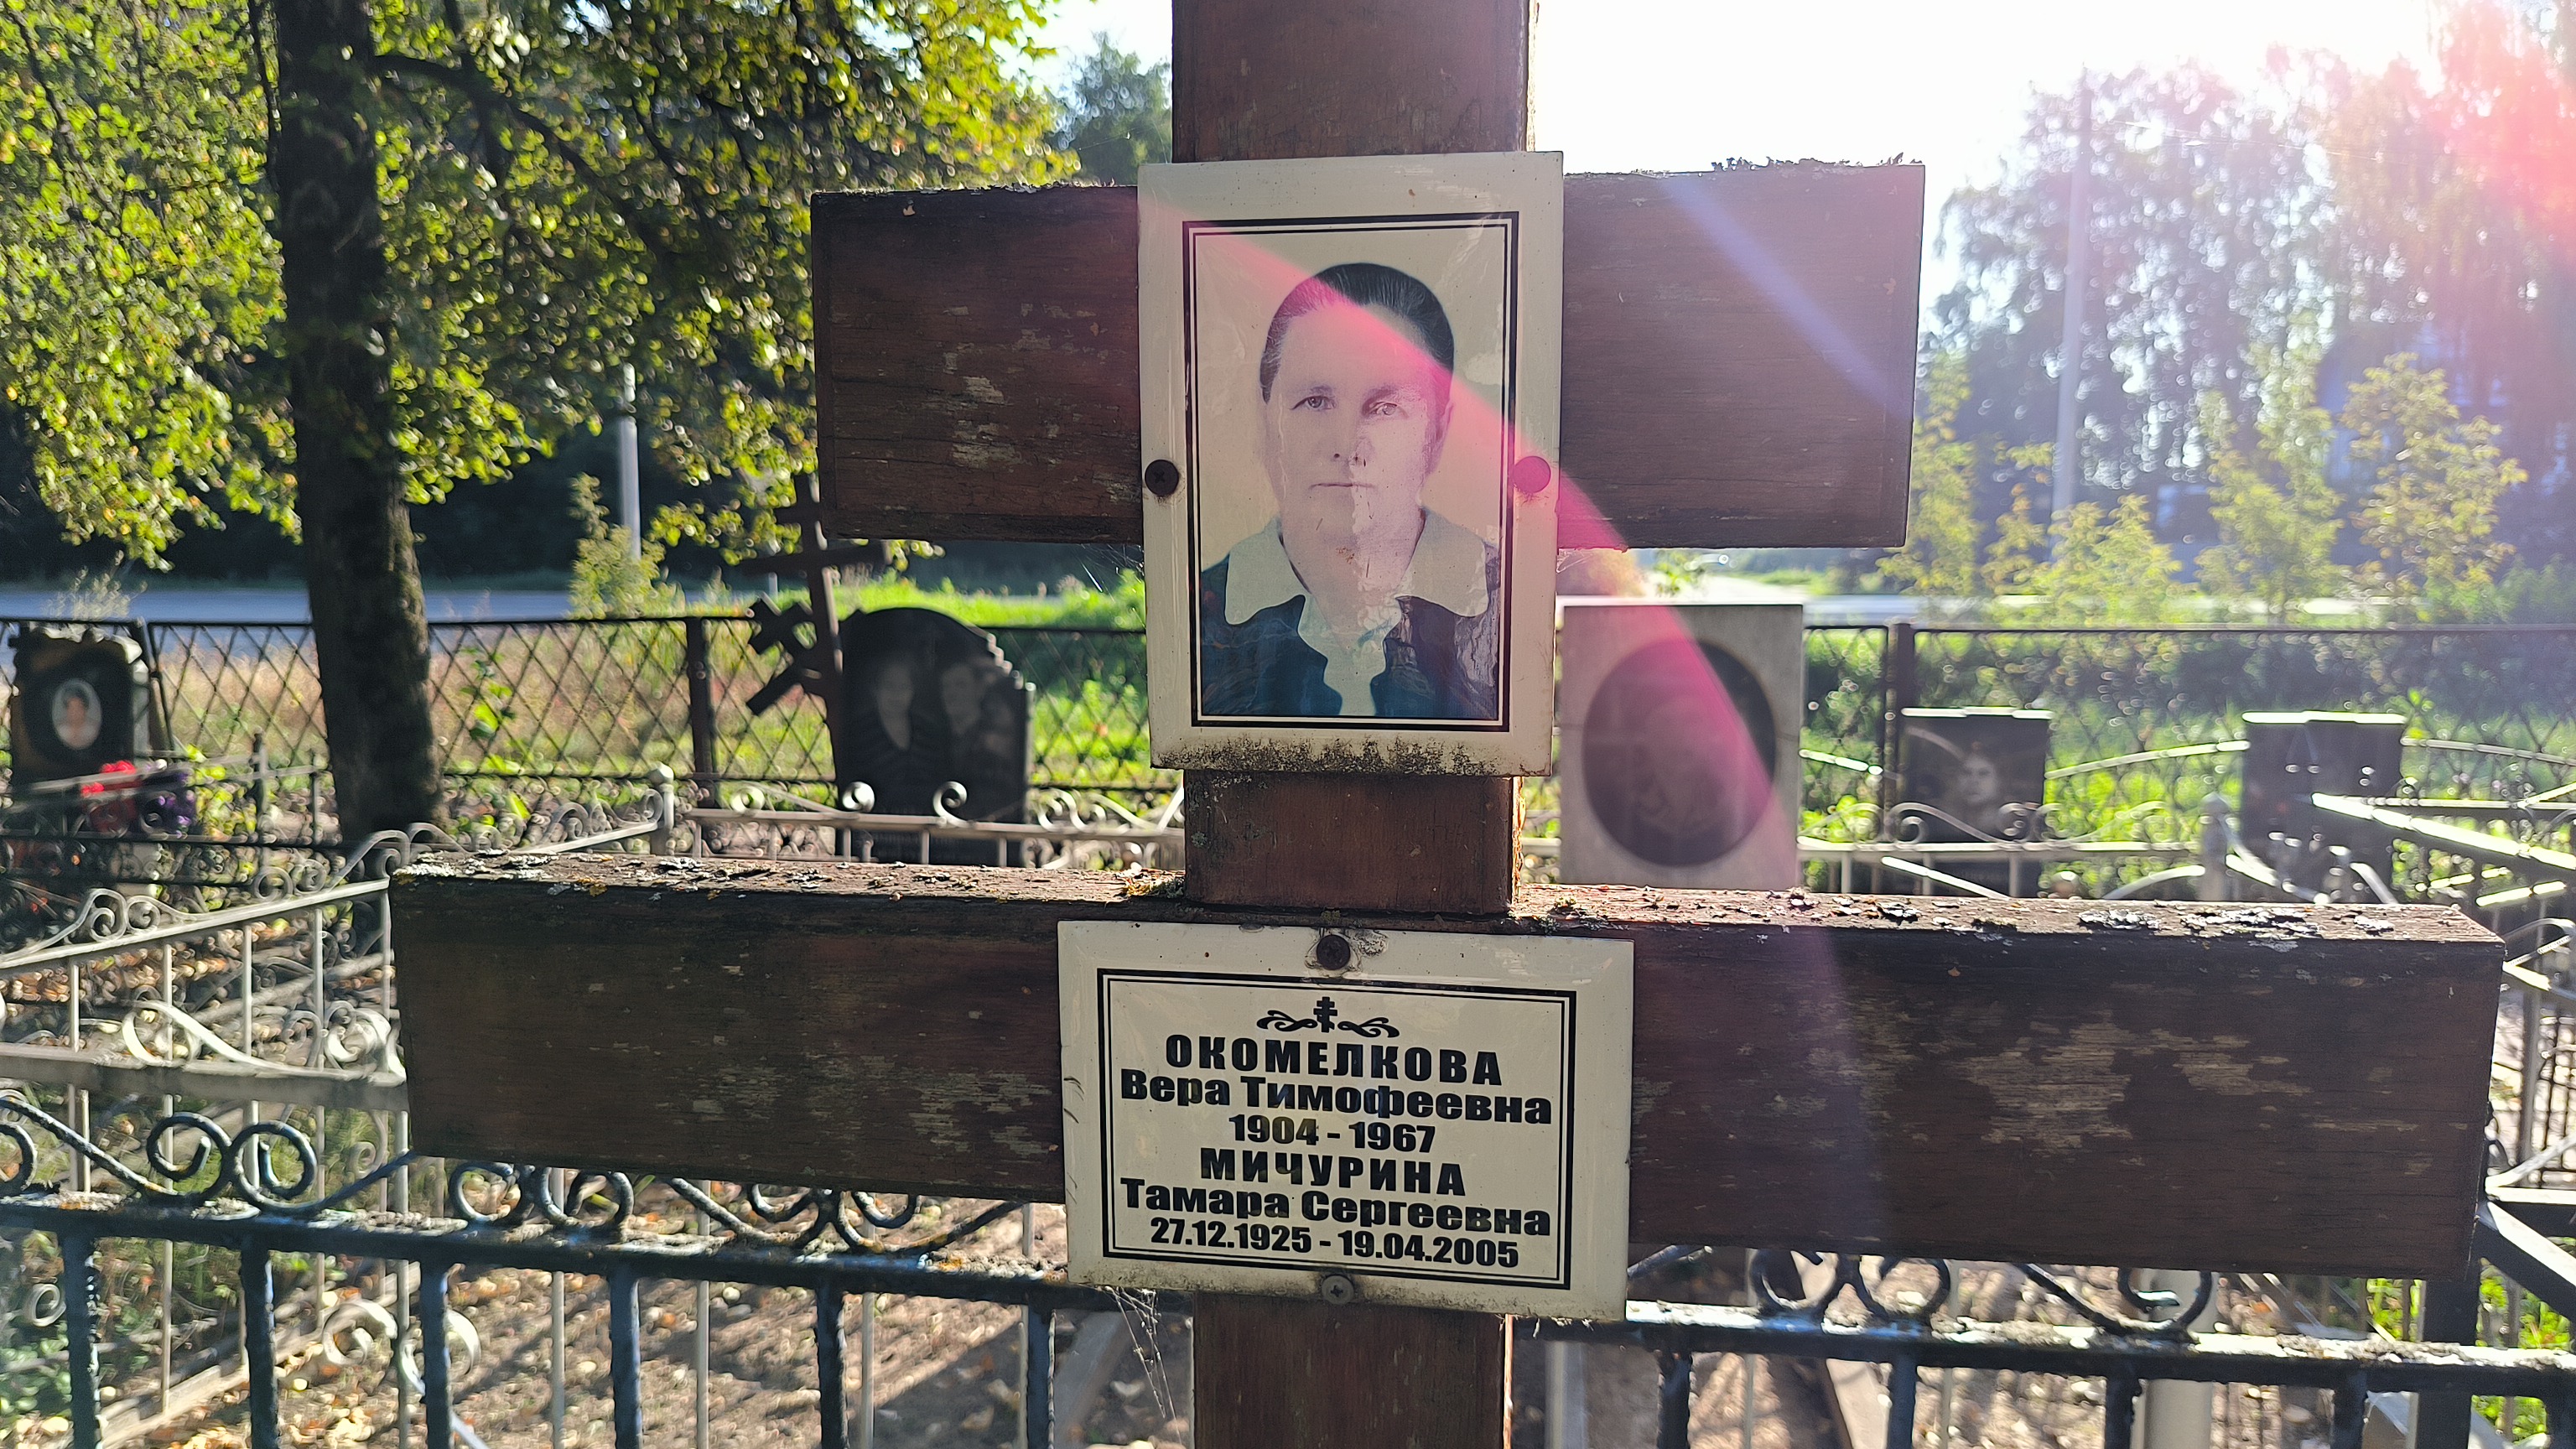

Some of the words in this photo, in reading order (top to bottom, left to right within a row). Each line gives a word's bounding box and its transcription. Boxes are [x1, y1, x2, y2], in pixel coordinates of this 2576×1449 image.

[1166, 1034, 1503, 1087] ОКОМЕЛКОВА
[1120, 1067, 1231, 1107] Вера
[1239, 1075, 1552, 1124] Тимофеевна
[1228, 1114, 1320, 1146] 1904
[1348, 1121, 1436, 1154] 1967
[1200, 1147, 1466, 1197] МИЧУРИНА
[1119, 1176, 1290, 1220] Тамара
[1301, 1190, 1550, 1237] Сергеевна
[1150, 1216, 1312, 1254] 27.12.1925
[1337, 1229, 1519, 1269] 19.04.2005
